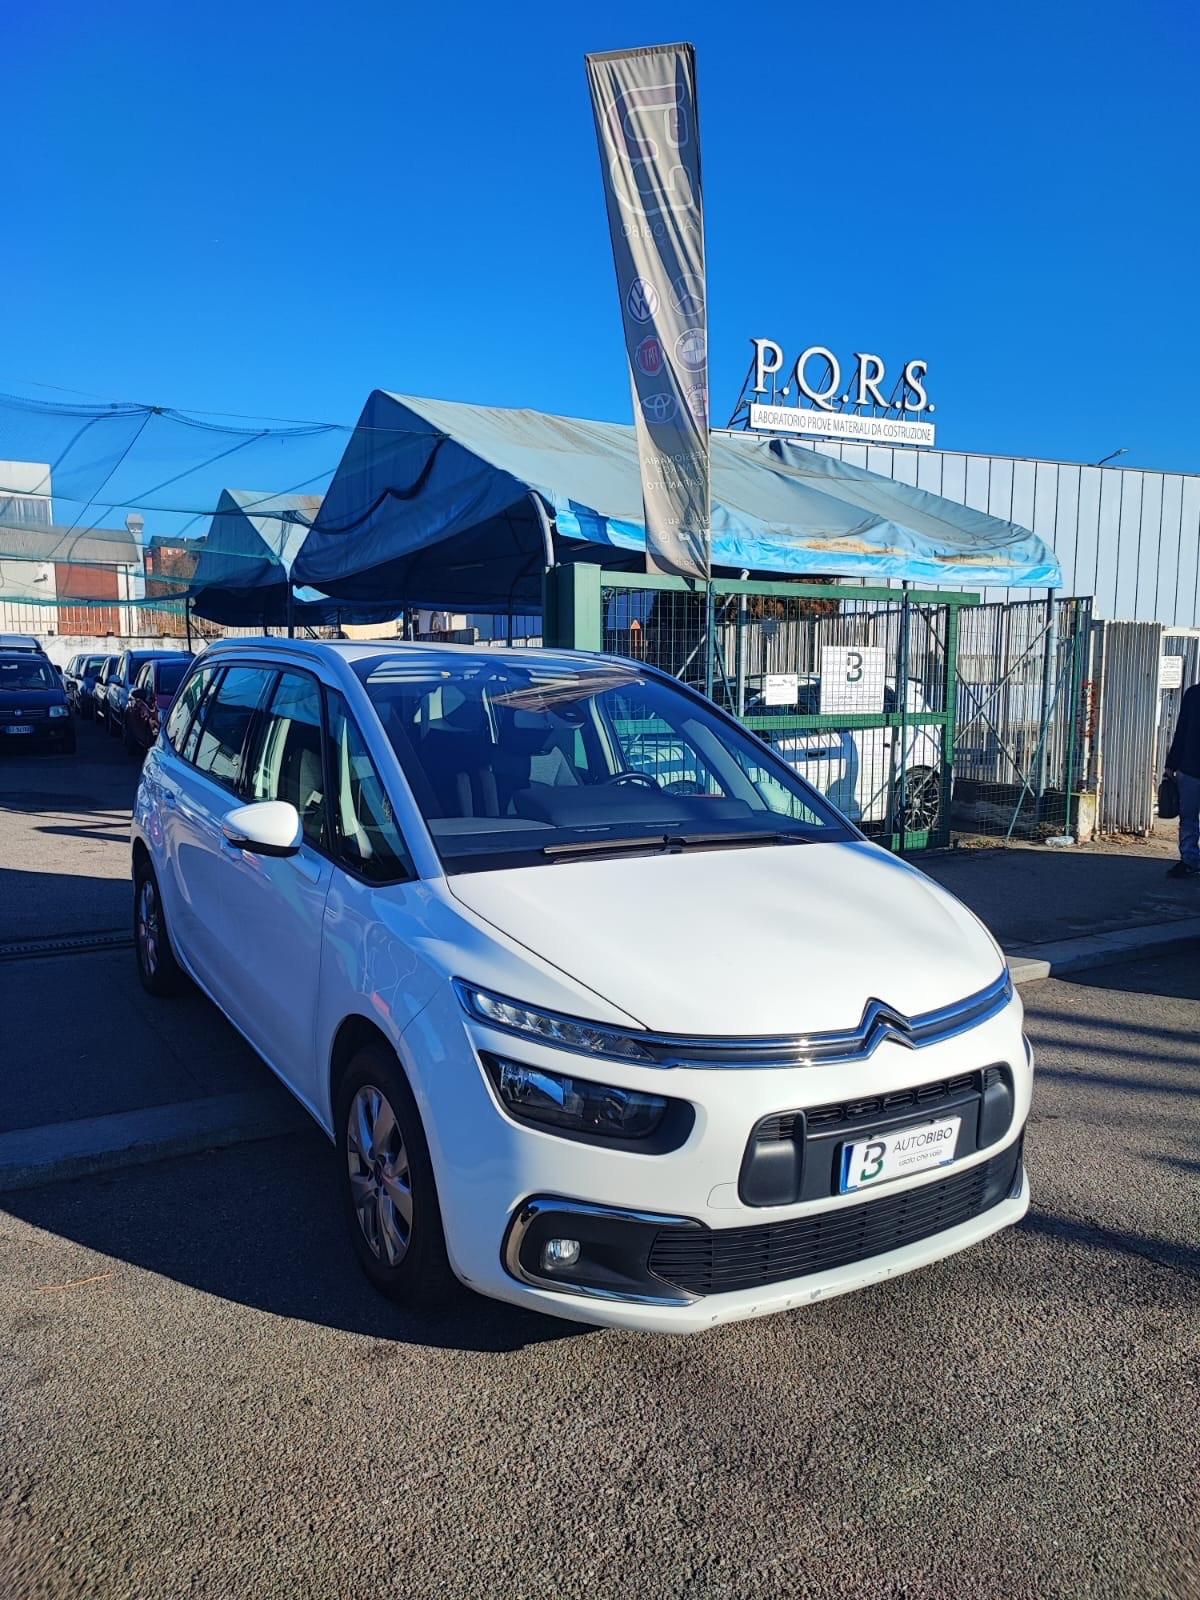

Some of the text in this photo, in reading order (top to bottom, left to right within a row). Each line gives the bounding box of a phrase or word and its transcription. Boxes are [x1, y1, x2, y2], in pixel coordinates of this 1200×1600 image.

[751, 338, 935, 412] P.Q.R.S.
[753, 409, 932, 440] LABORATORIO PROVE MATERIALI DA COSTRUZIONE
[893, 1128, 953, 1153] AUTOBIBO
